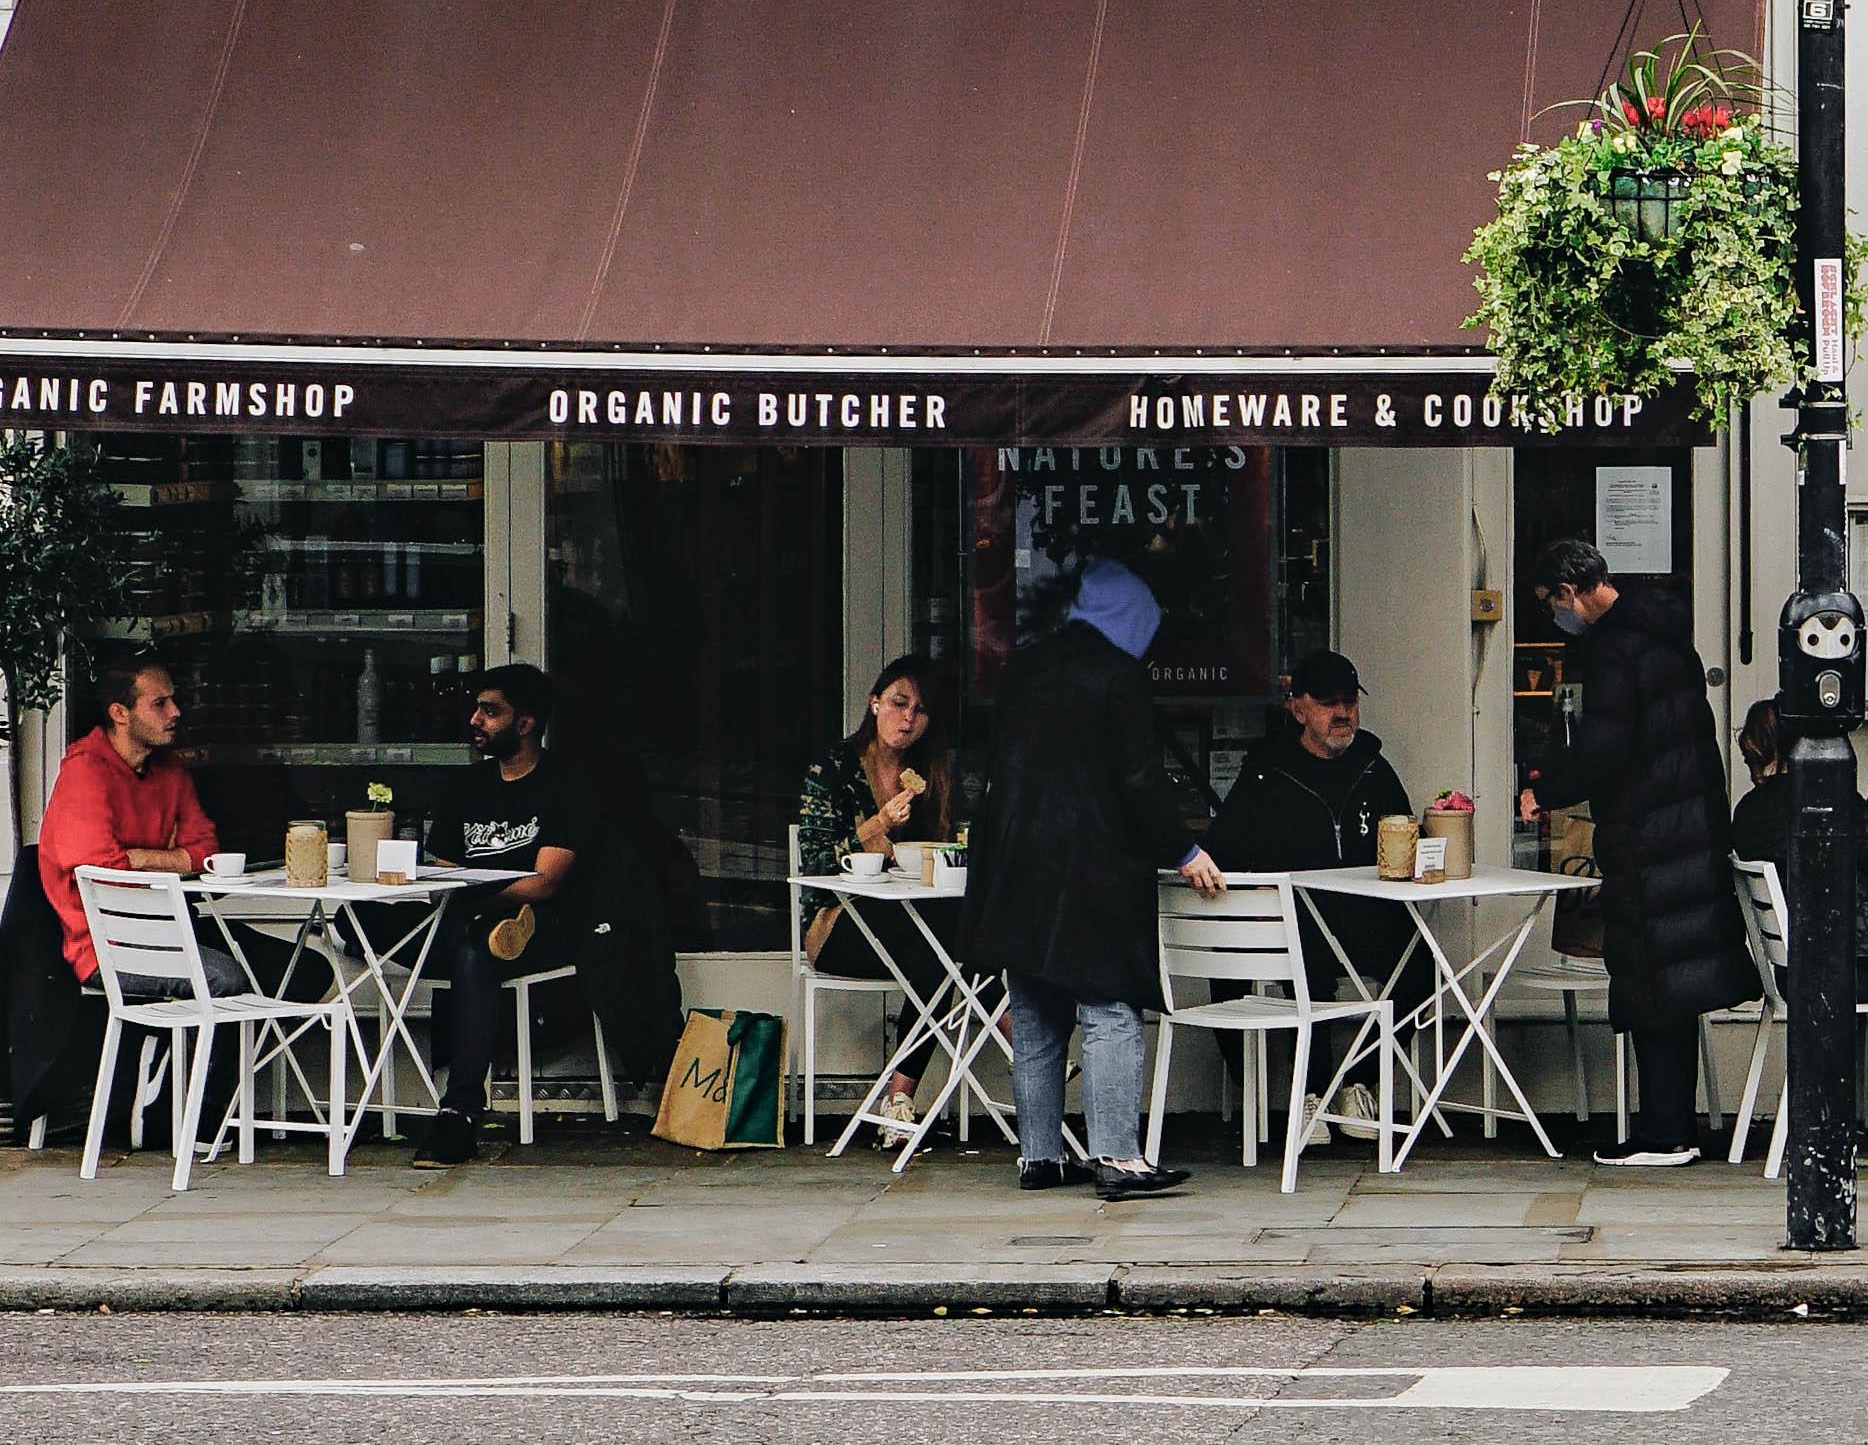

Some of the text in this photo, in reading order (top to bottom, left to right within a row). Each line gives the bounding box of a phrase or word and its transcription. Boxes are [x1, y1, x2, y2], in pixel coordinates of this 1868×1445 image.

[0, 378, 354, 418] ANIC FARMSHOP
[549, 389, 946, 429] ORGANIC BUTCHER
[1129, 394, 1348, 429] HOMEWARE
[1374, 394, 1397, 427] &
[997, 446, 1247, 472] NATURES
[1045, 484, 1201, 525] FEAST
[1151, 666, 1228, 681] ORGANIC
